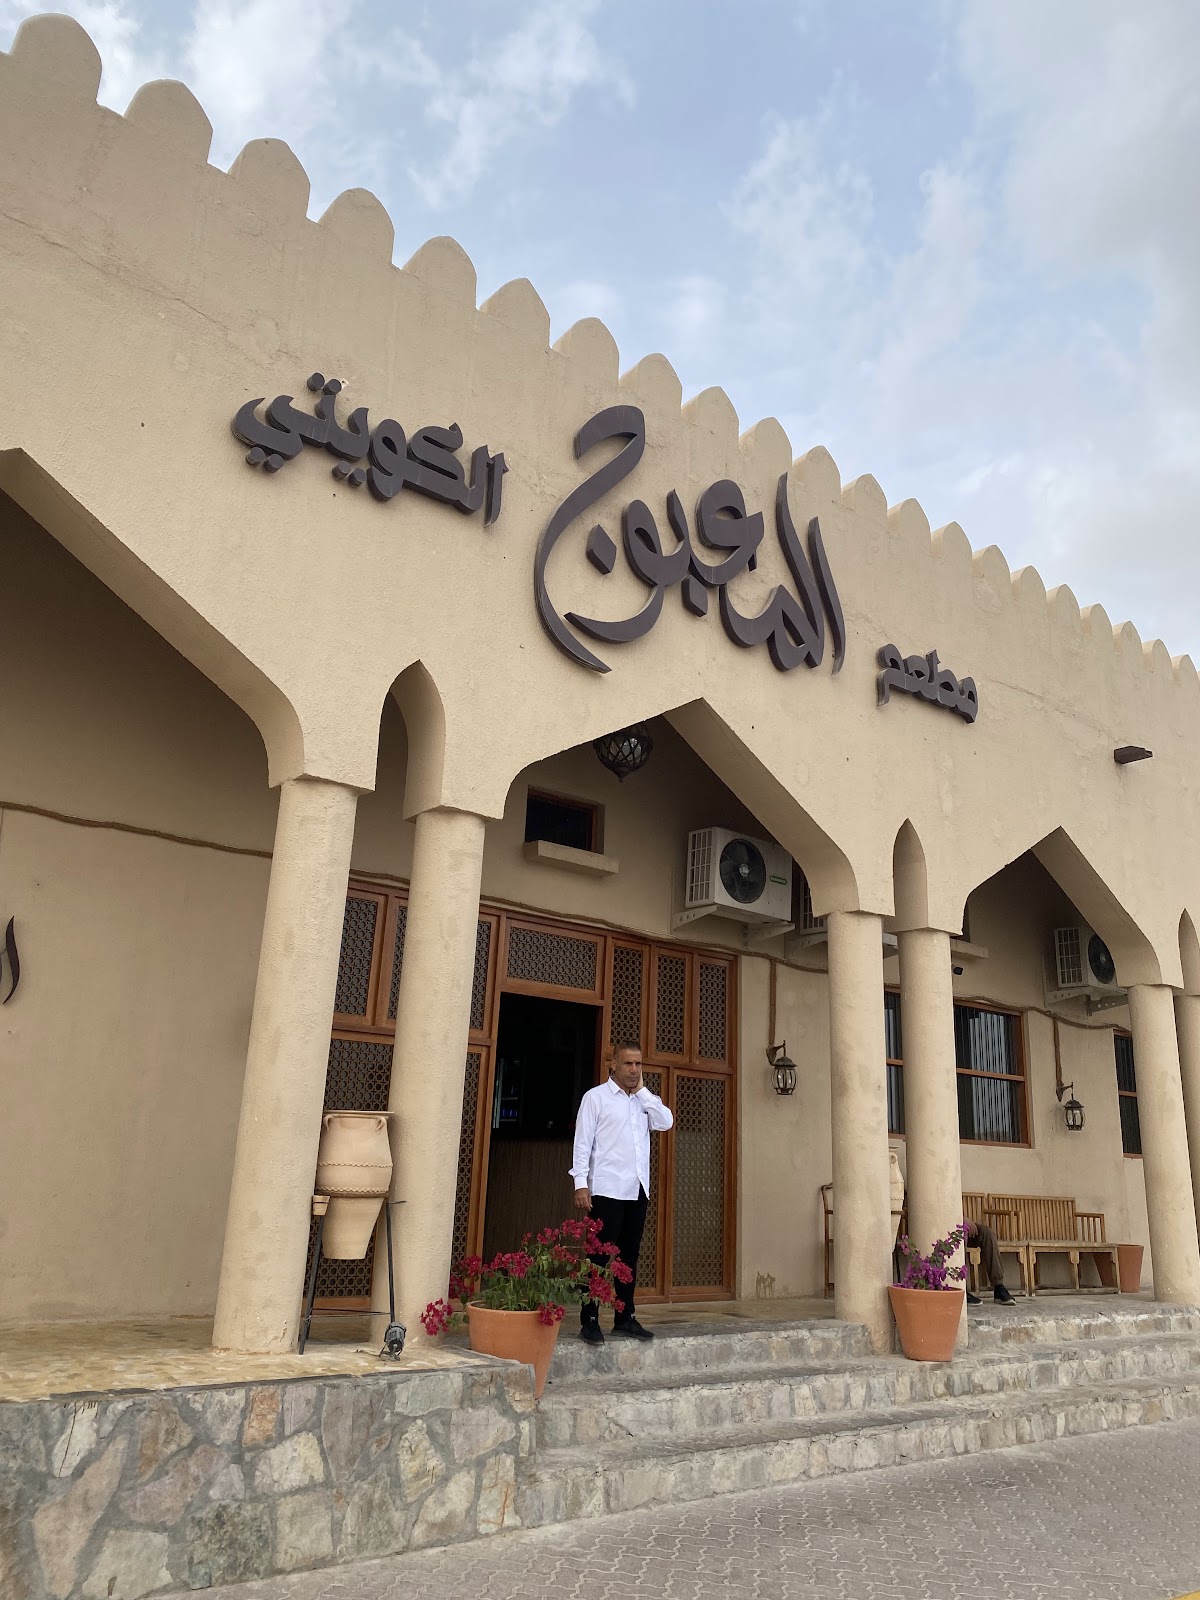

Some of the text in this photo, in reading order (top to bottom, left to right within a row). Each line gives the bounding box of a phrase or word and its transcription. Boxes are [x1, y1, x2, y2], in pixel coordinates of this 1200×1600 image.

[231, 372, 979, 724] مطعم المعبوج الكويتي
